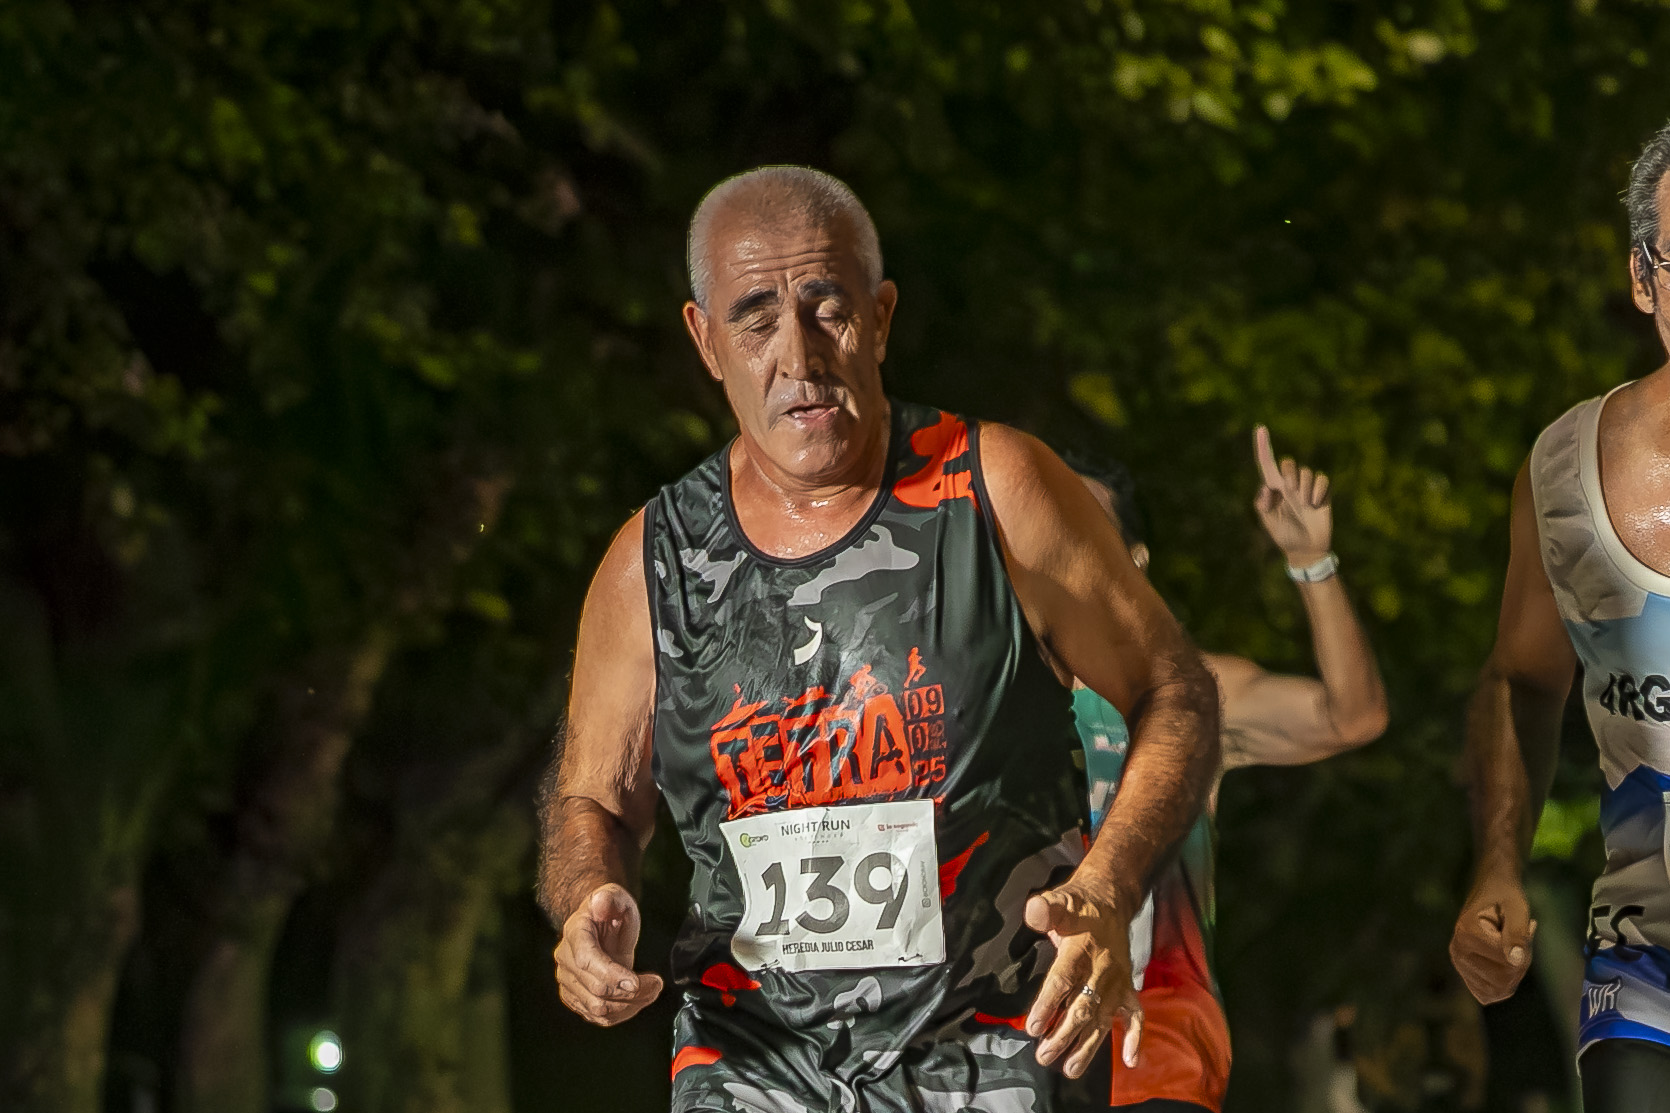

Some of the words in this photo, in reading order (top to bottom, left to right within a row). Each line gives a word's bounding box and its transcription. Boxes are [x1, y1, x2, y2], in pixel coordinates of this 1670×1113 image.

[781, 821, 819, 836] NIGHT
[822, 819, 850, 831] RUN
[755, 851, 908, 936] 139
[782, 942, 819, 955] HEREDIA
[821, 941, 844, 953] JULIO
[845, 939, 875, 952] CESAR
